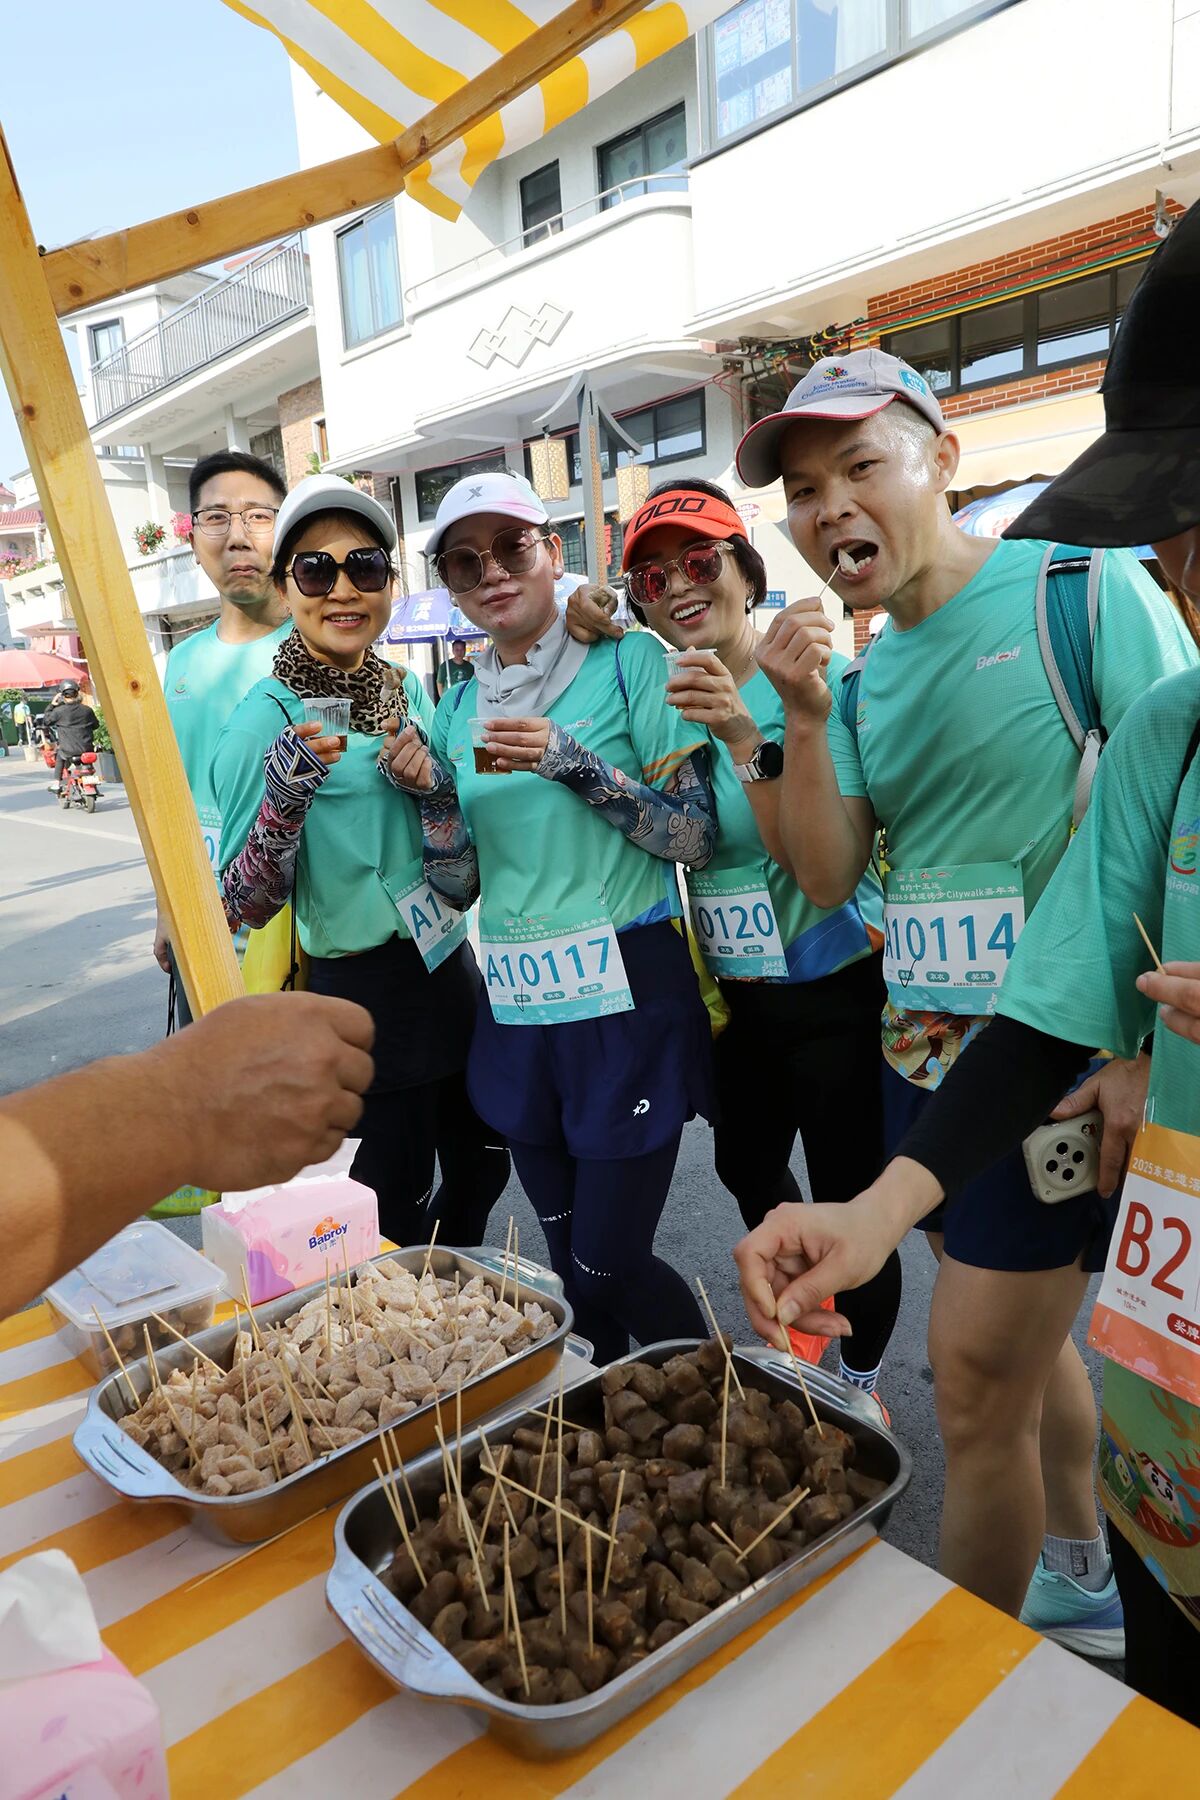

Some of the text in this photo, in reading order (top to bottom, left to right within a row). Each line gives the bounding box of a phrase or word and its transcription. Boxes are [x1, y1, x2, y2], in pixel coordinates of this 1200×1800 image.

[410, 891, 442, 939] A1
[885, 912, 1017, 961] A10114
[487, 936, 610, 988] A10117
[308, 1223, 348, 1249] Babroy
[1115, 1201, 1192, 1300] B2
